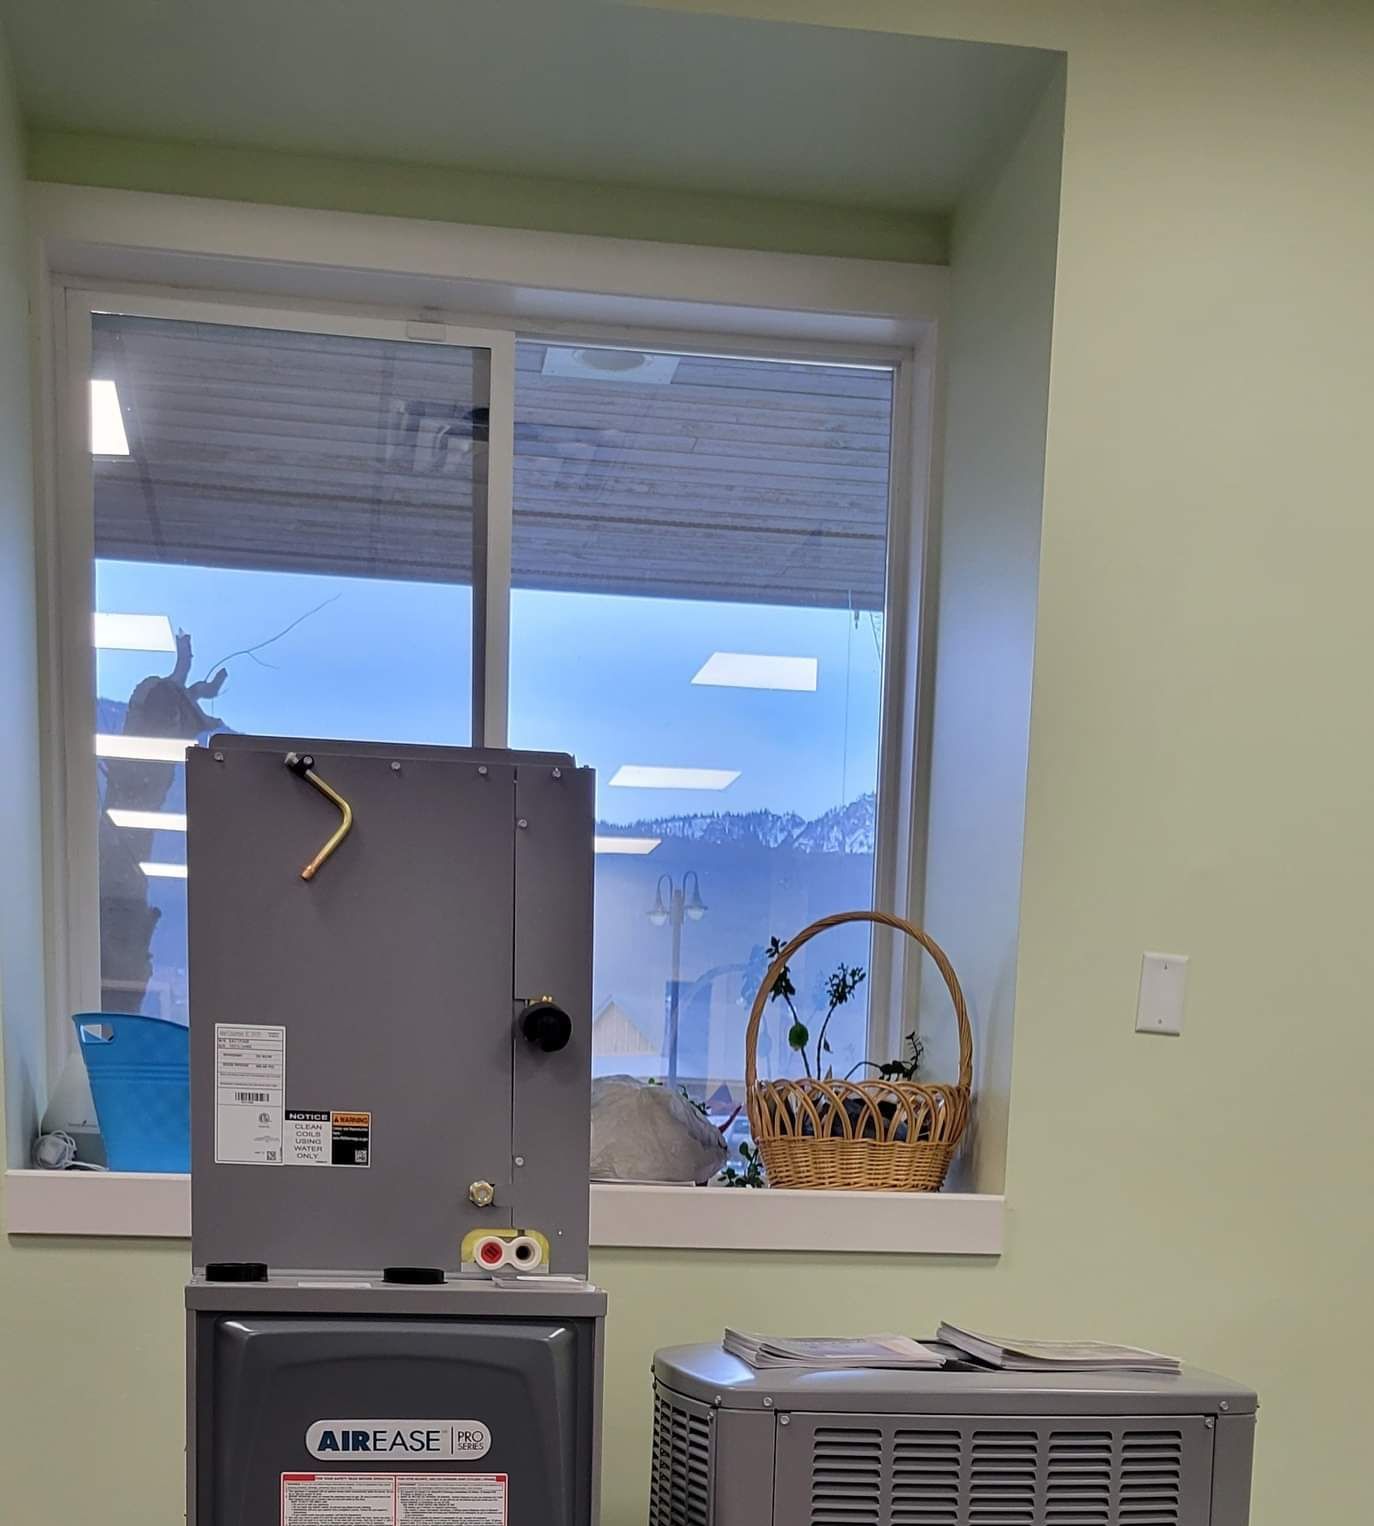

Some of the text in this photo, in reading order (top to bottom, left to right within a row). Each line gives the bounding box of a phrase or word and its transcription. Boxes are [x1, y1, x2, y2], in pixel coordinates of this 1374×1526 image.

[317, 1430, 441, 1452] AIREASE
[457, 1430, 484, 1443] PRO
[457, 1442, 484, 1450] SERIES
